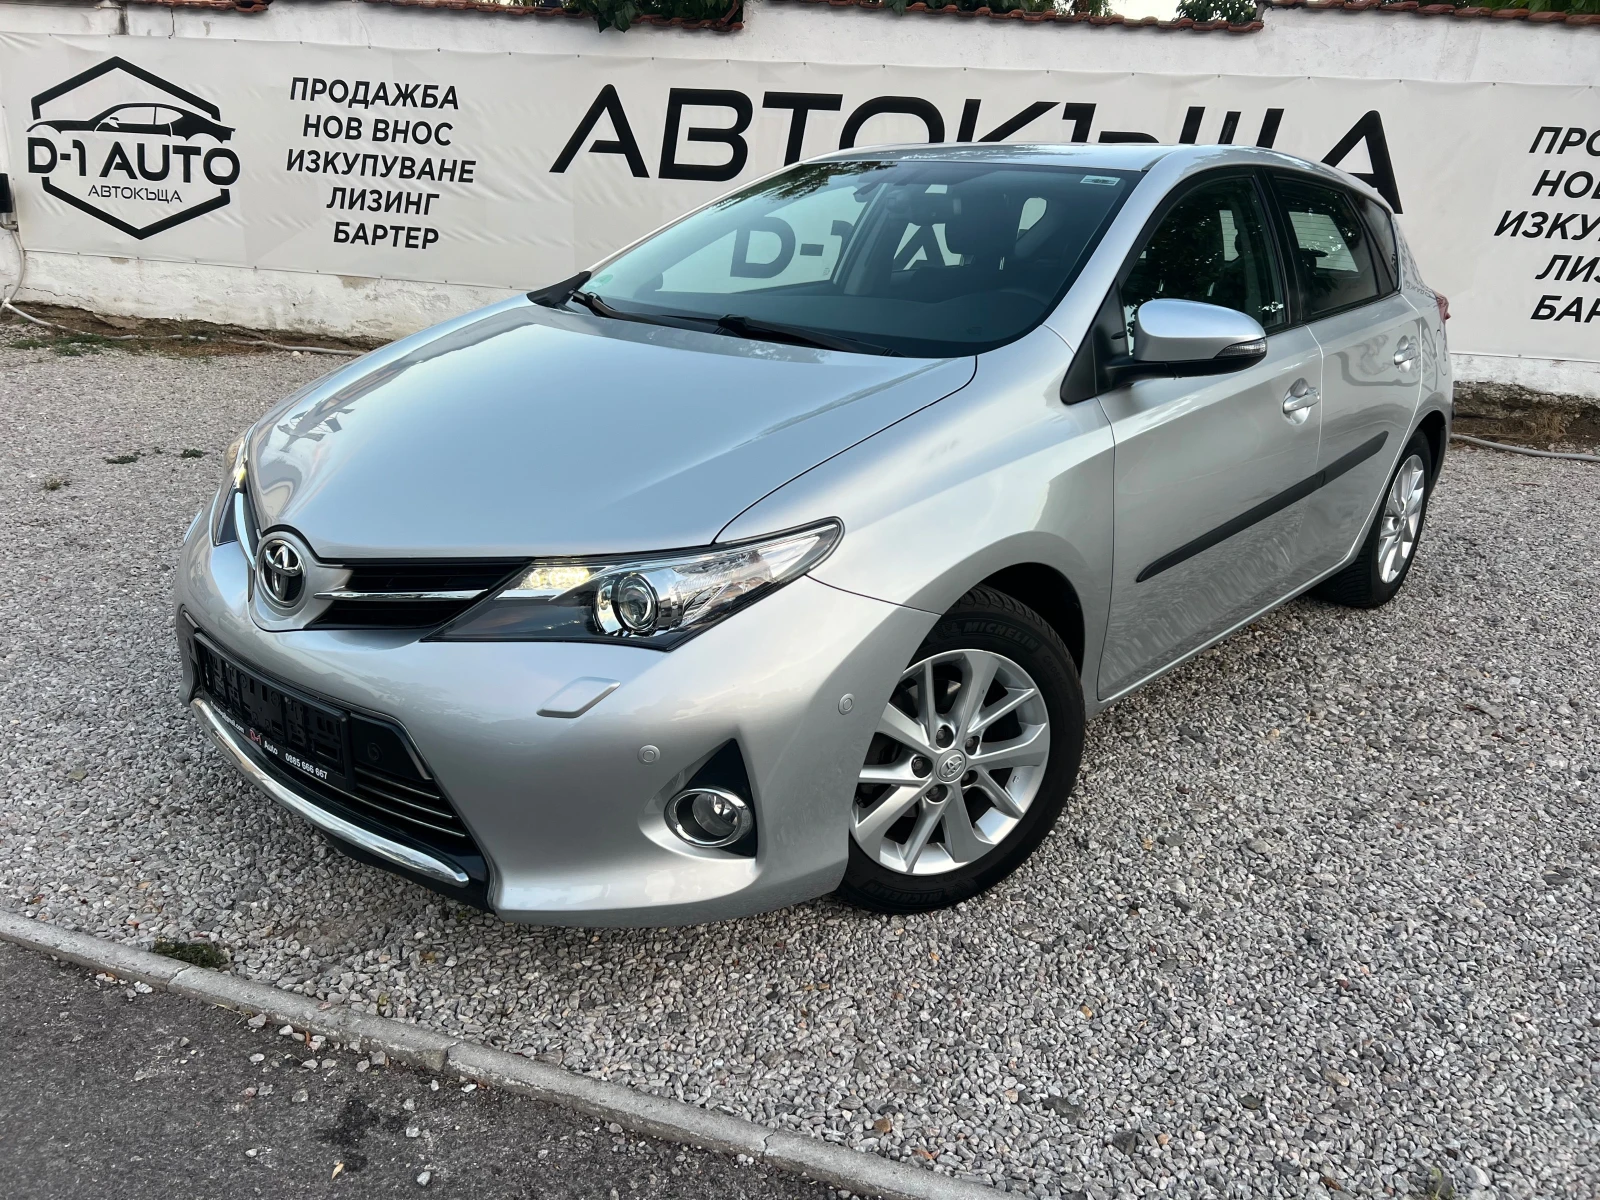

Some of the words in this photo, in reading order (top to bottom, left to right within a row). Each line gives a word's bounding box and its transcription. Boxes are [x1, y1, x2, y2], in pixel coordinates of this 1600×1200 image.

[290, 77, 459, 110] ПРОДАЖБА
[302, 113, 363, 140] НОВ
[371, 118, 454, 146] ВНОС
[27, 136, 88, 177] D-1
[98, 141, 241, 186] AUTO
[286, 148, 477, 184] ИЗКУПУВАНЕ
[87, 184, 183, 204] АВТОКЪЩА
[1531, 169, 1600, 199] НО
[326, 186, 440, 216] ЛИЗИНГ
[333, 221, 439, 250] БАРТЕР
[1534, 254, 1600, 284] ЛИ
[963, 620, 1039, 650] MICHELIN
